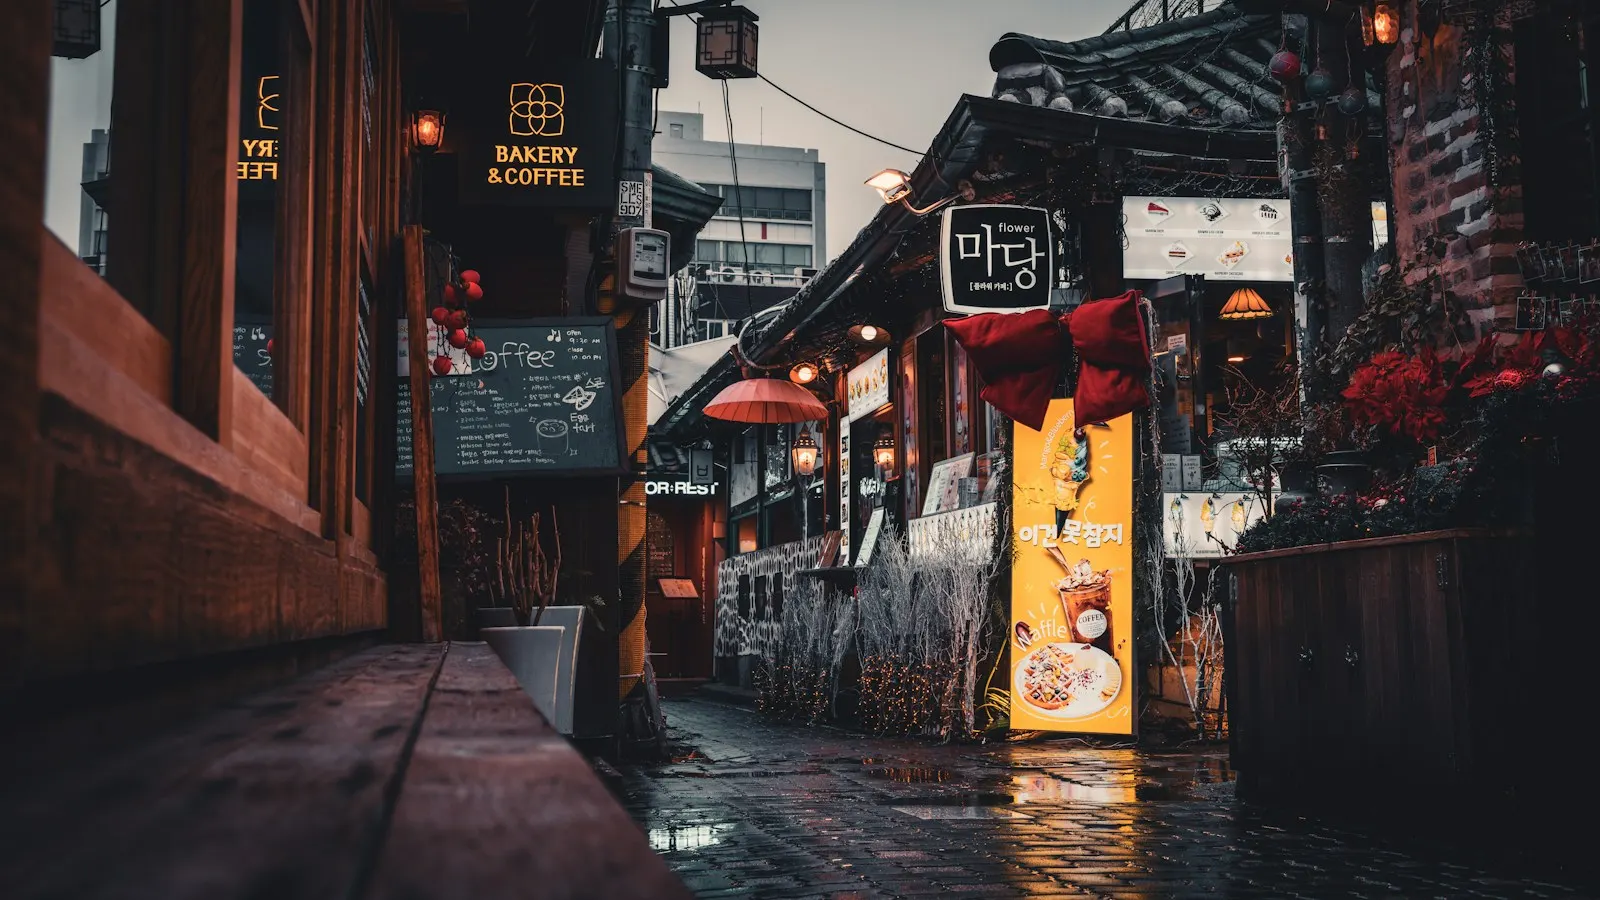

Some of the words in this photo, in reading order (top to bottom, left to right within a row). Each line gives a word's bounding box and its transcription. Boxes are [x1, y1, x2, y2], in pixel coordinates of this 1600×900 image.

[495, 145, 578, 164] BAKERY
[998, 222, 1035, 233] flower
[955, 223, 1046, 290] 마당
[1018, 523, 1058, 548] 이건
[1078, 612, 1105, 624] COFFEE
[1013, 618, 1067, 652] Waffle
